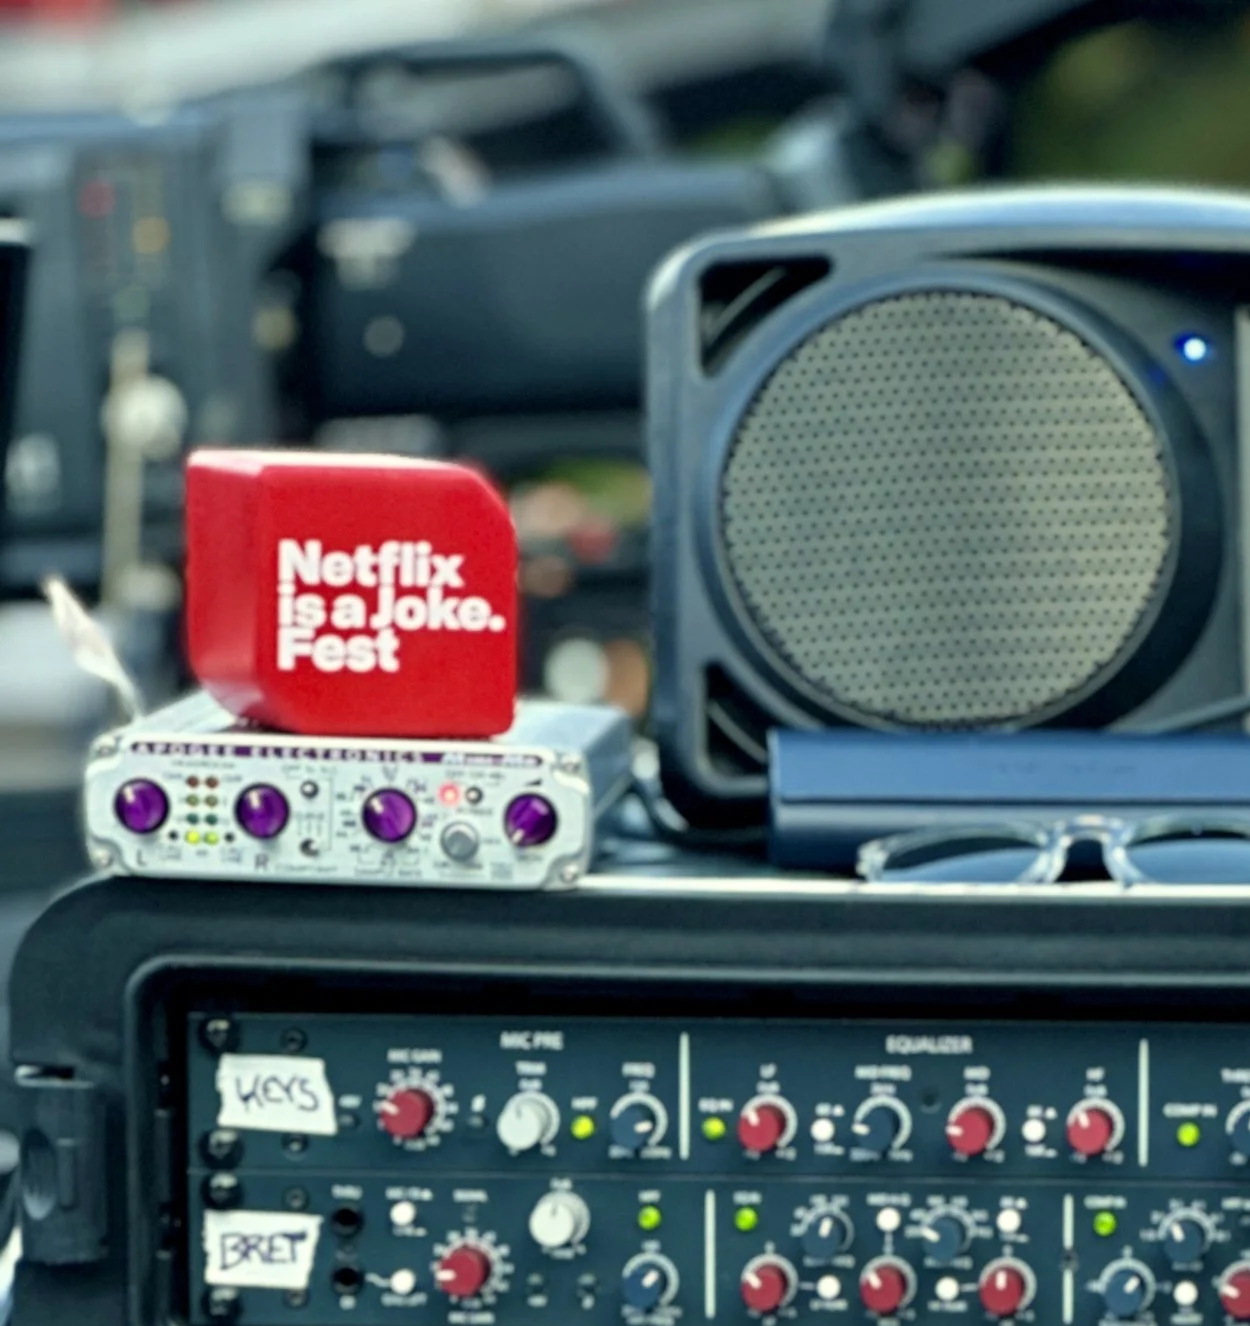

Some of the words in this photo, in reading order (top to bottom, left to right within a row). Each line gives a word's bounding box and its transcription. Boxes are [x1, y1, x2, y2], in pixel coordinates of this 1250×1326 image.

[278, 539, 464, 587] Netflix
[278, 584, 326, 628] is
[332, 594, 366, 629] a
[369, 586, 506, 632] Joke.
[278, 627, 400, 672] Fest
[134, 742, 234, 757] APOGEE
[250, 745, 422, 764] ELECTRONICS
[885, 1035, 973, 1054] EQUALIZER
[235, 1074, 318, 1112] KEYS
[220, 1231, 307, 1270] BRET
